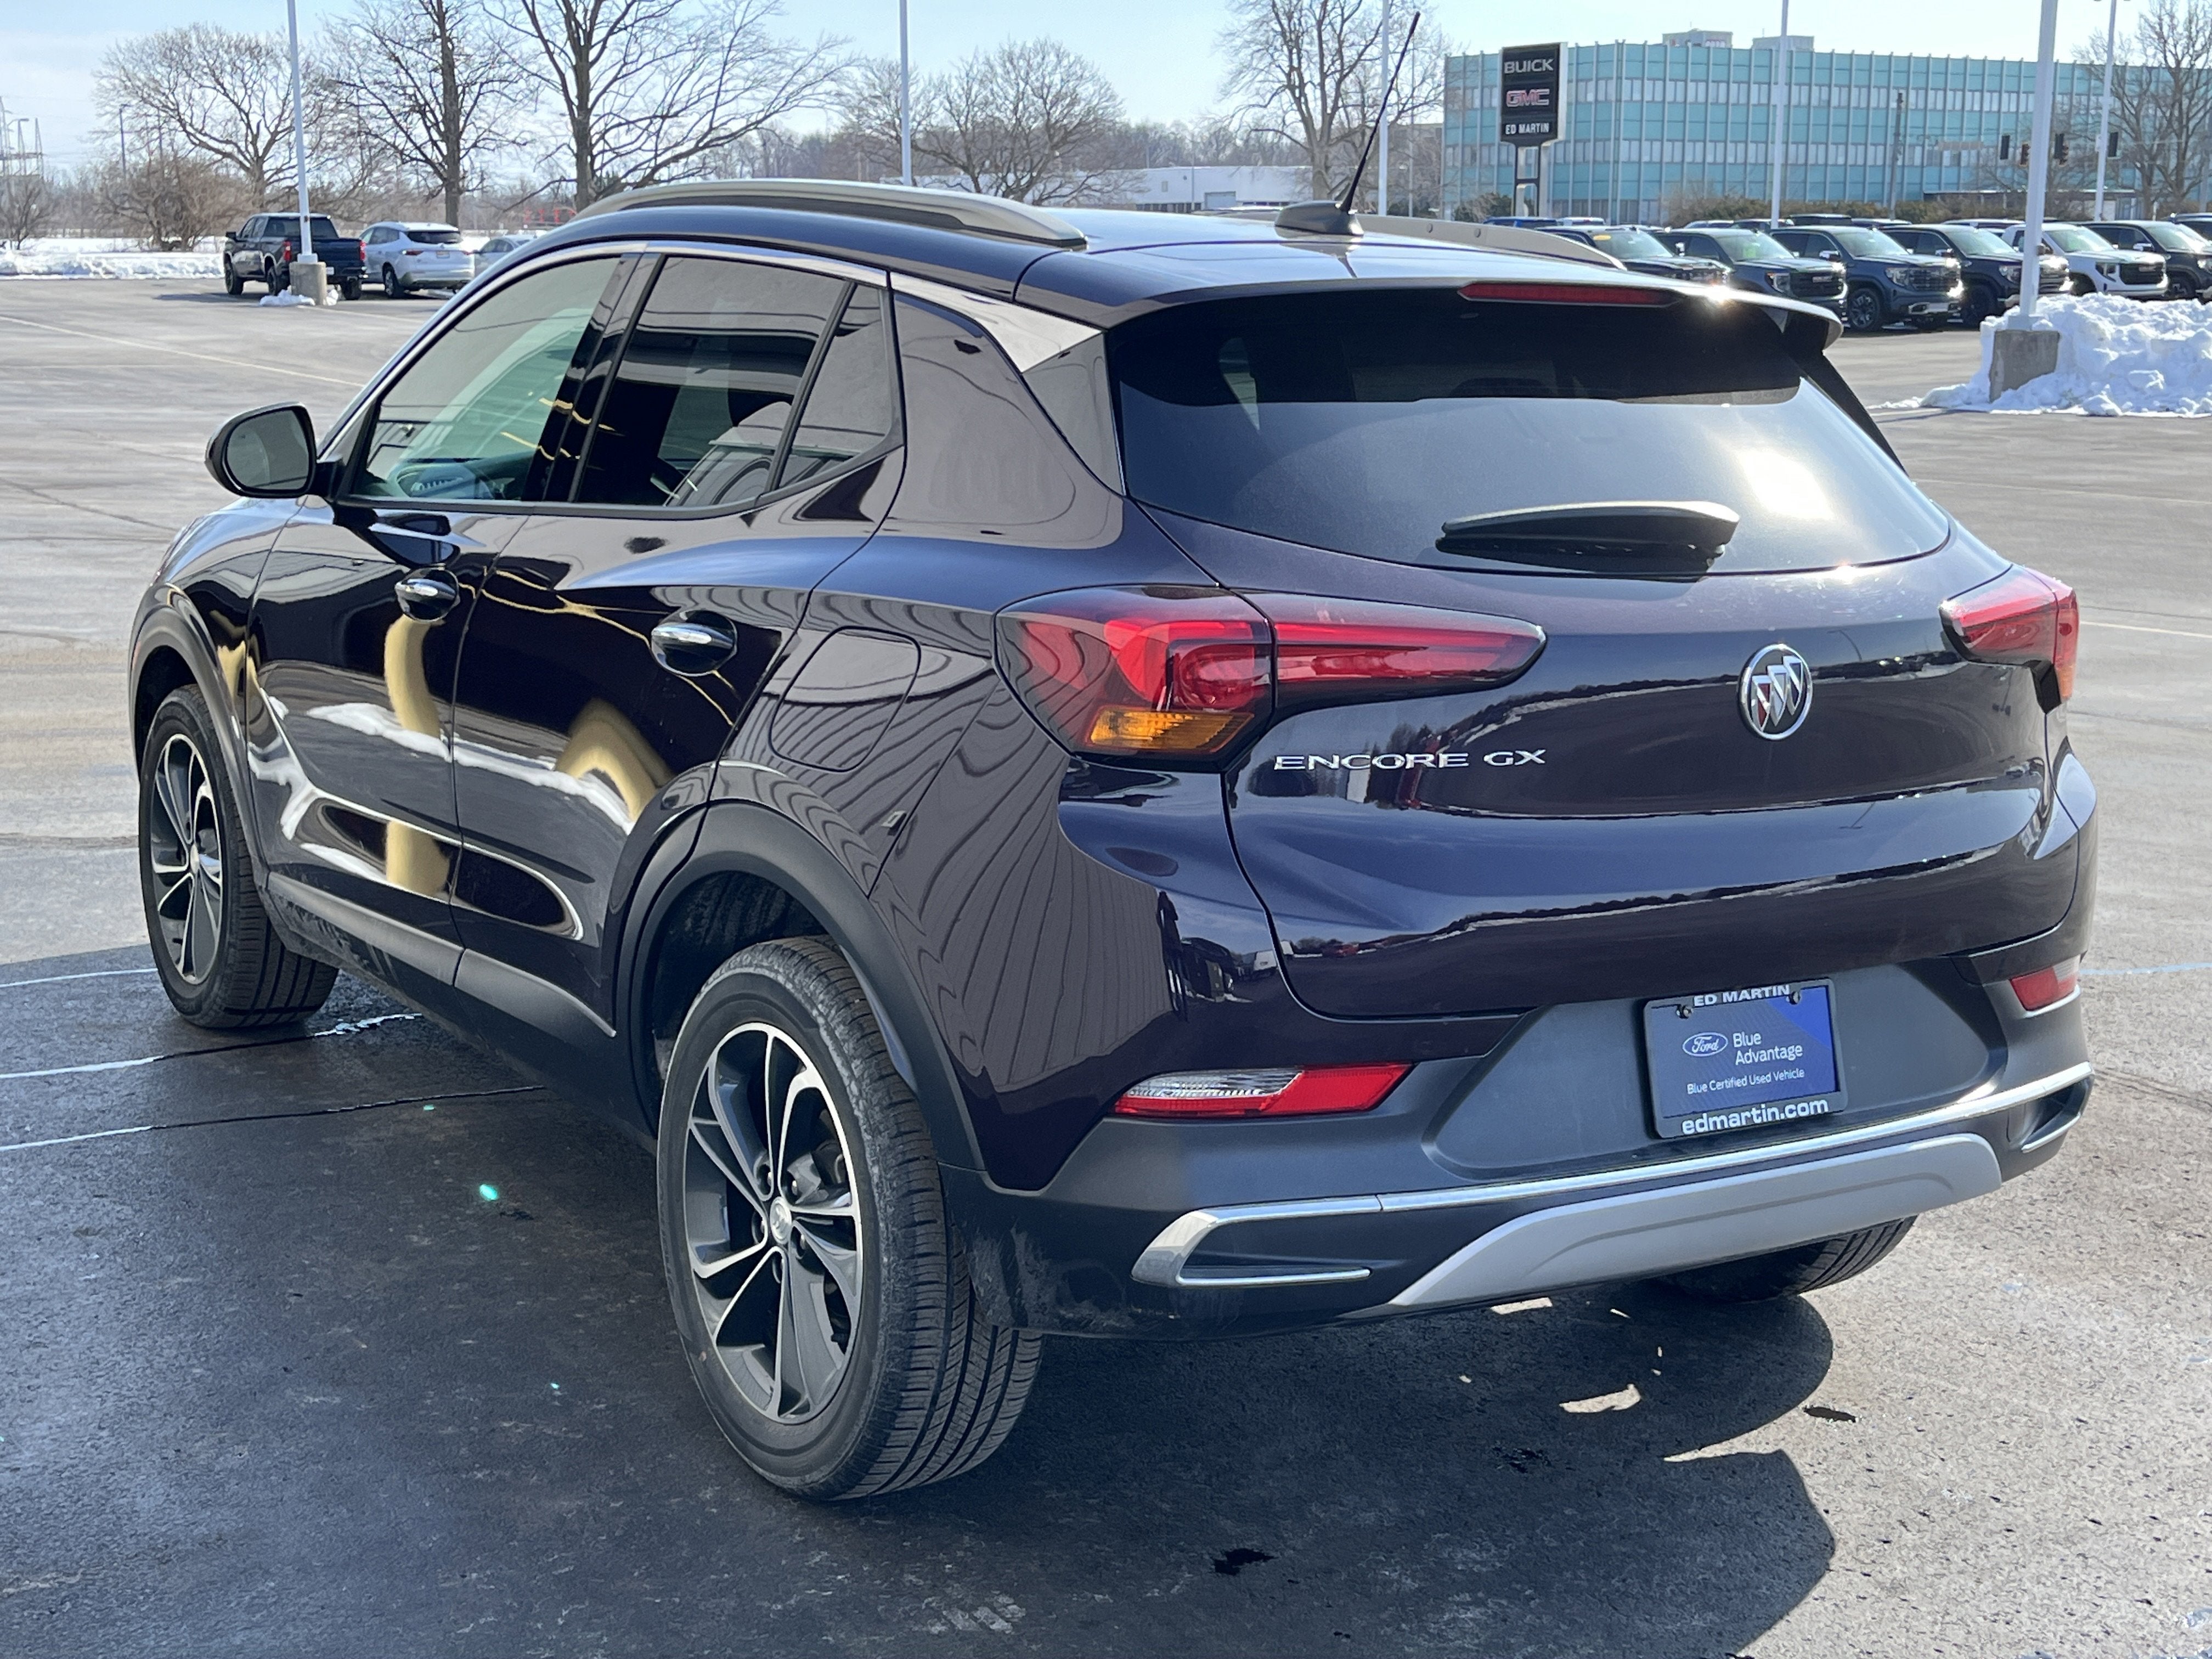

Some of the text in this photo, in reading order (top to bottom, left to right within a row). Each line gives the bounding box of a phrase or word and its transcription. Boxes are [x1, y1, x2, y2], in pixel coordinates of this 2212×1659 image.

[1504, 59, 1554, 74] BUICK
[1506, 88, 1550, 107] GMC
[1505, 122, 1550, 134] ED MARTIN
[1273, 749, 1547, 770] ENCORE GX
[1692, 984, 1791, 1007] ED MARTIN
[1691, 1035, 1719, 1053] Ford
[1733, 1031, 1762, 1048] Blue
[1735, 1043, 1803, 1065] Advantage
[1686, 1068, 1805, 1095] Blue Certified Used Vehicle
[1681, 1099, 1829, 1135] edmartin.com
